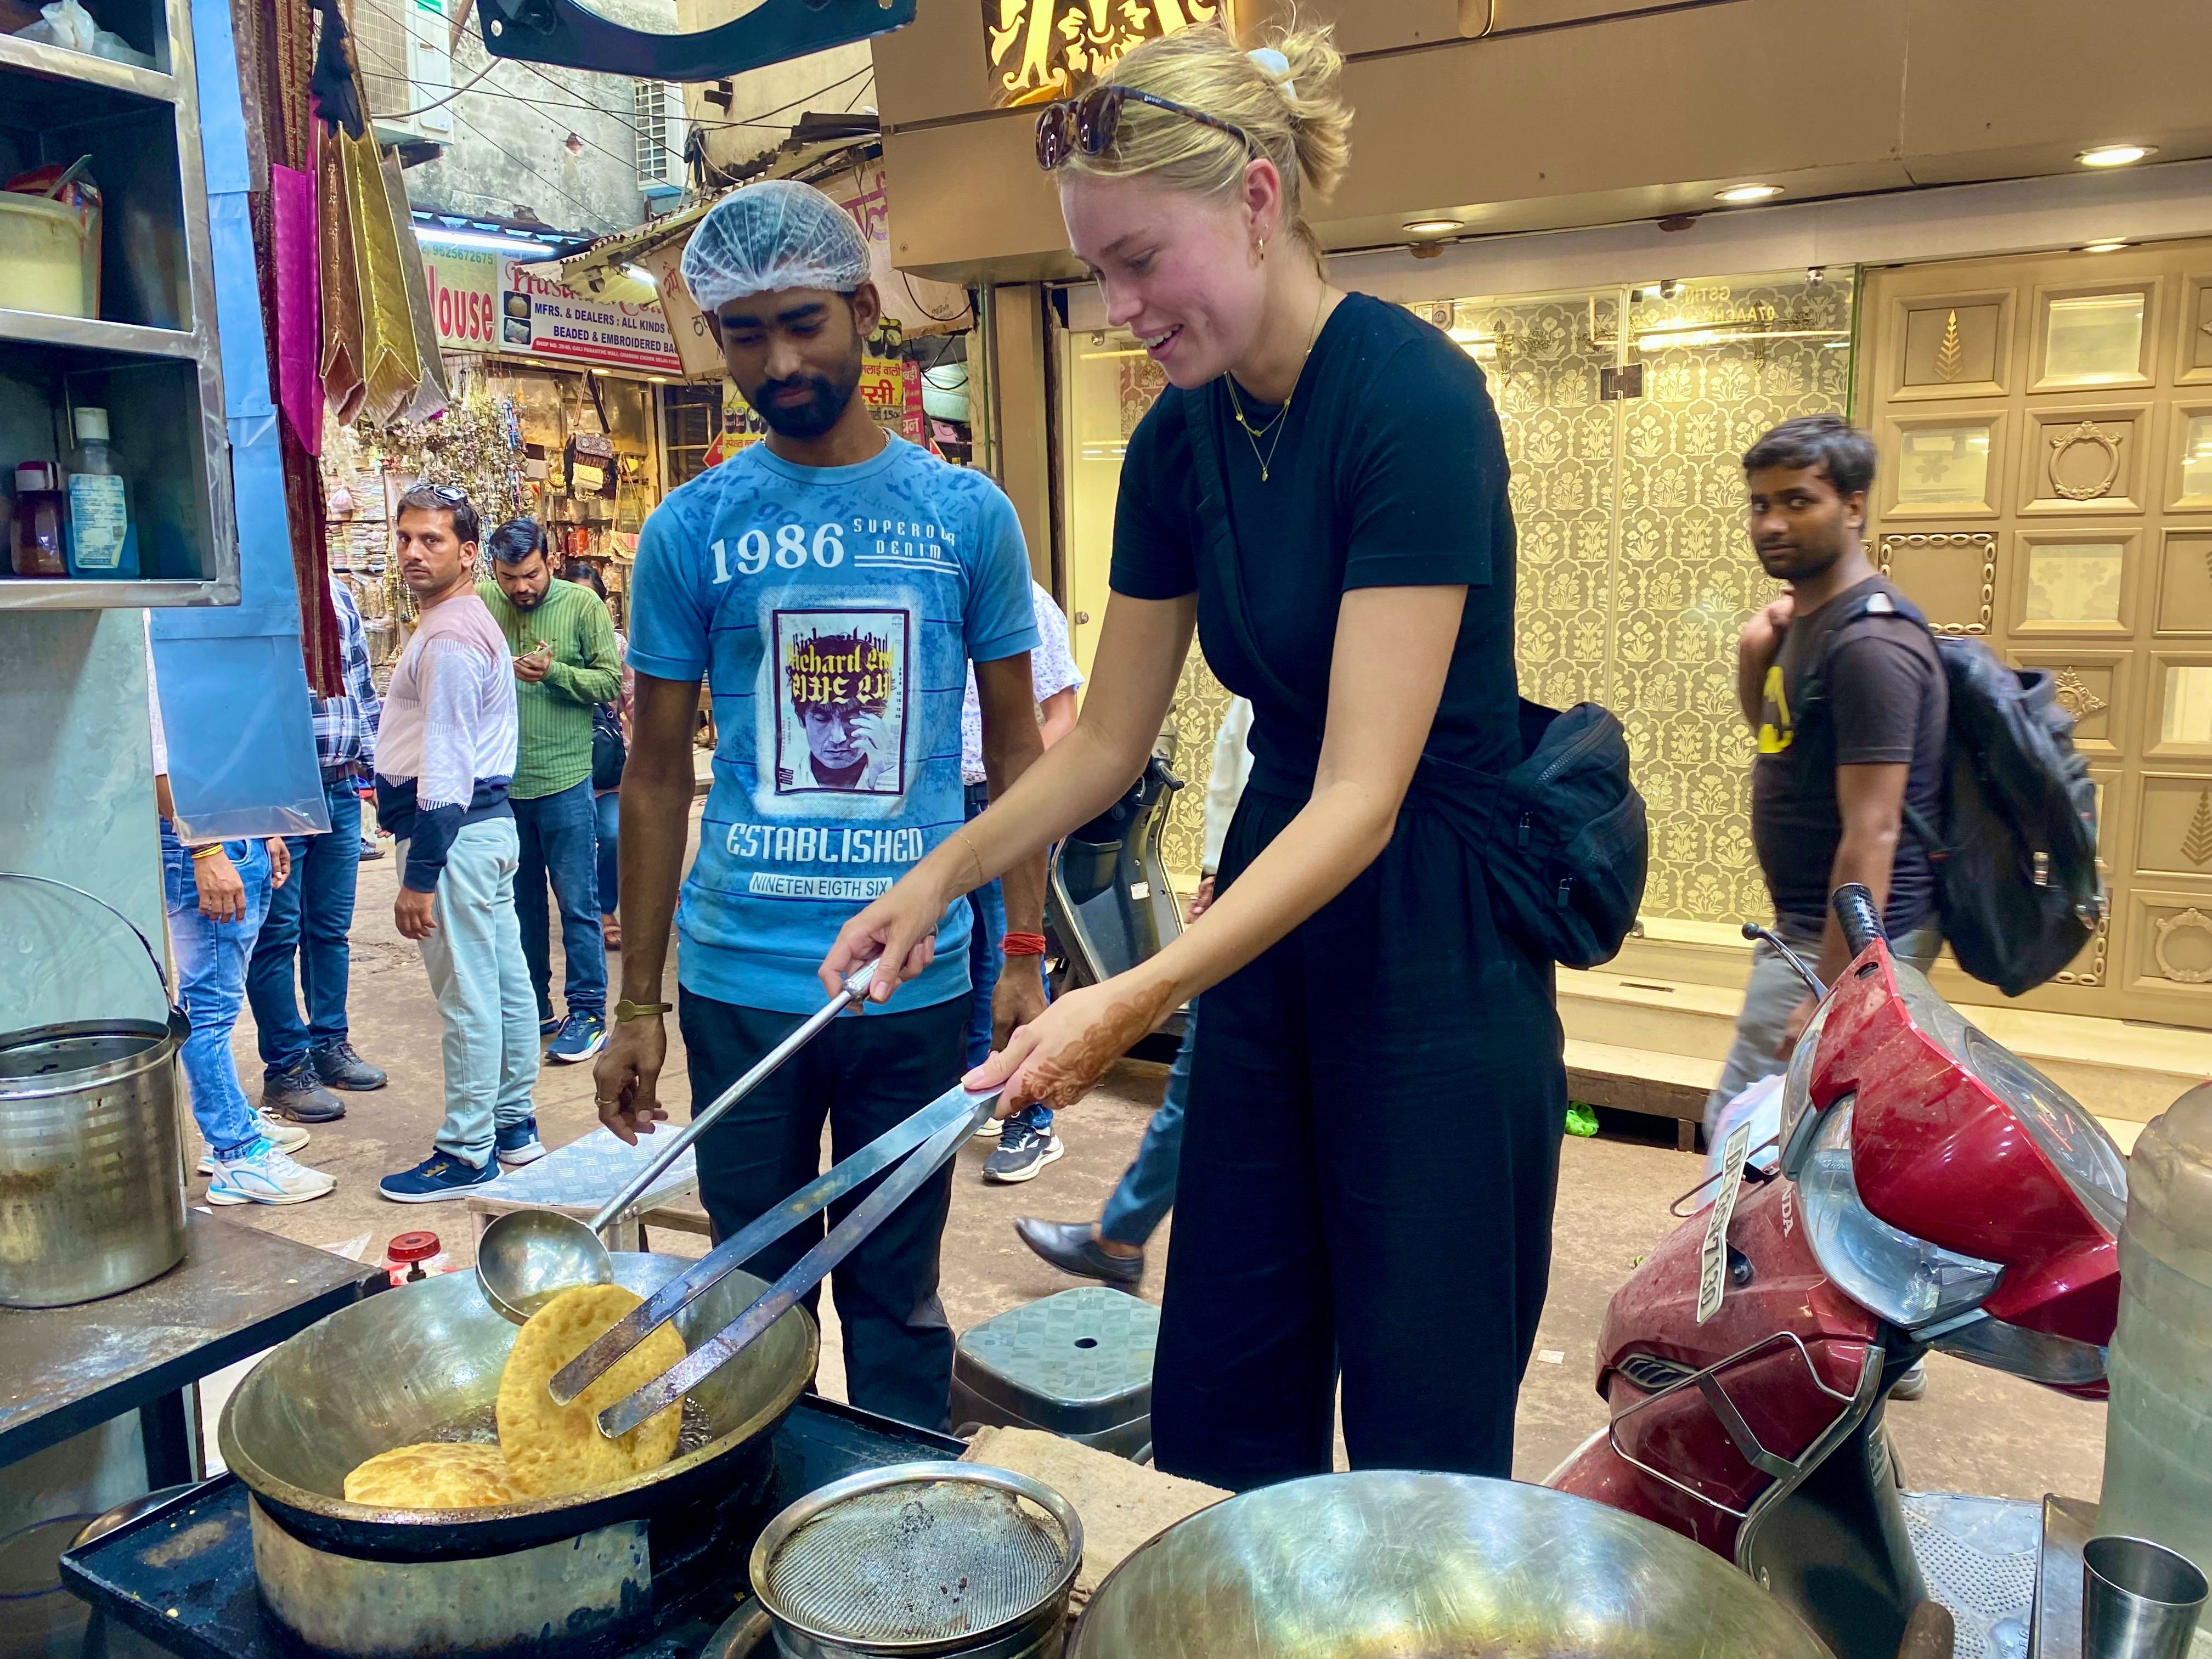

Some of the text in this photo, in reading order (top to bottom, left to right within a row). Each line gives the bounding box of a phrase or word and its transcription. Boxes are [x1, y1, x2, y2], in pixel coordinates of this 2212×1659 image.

[535, 303, 562, 318] MFRS.
[566, 308, 572, 318] &
[575, 309, 614, 325] DEALERS
[622, 317, 637, 329] ALL
[640, 320, 665, 334] KINDS
[554, 325, 589, 340] BEADED
[592, 331, 598, 342] &
[601, 333, 661, 351] EMBROIDERED
[884, 364, 900, 376] वाली
[711, 523, 844, 585] 1986
[876, 540, 941, 560] DENIM
[726, 823, 923, 863] ESTABLISHED
[752, 875, 888, 896] NINETEN EIGTH SIX
